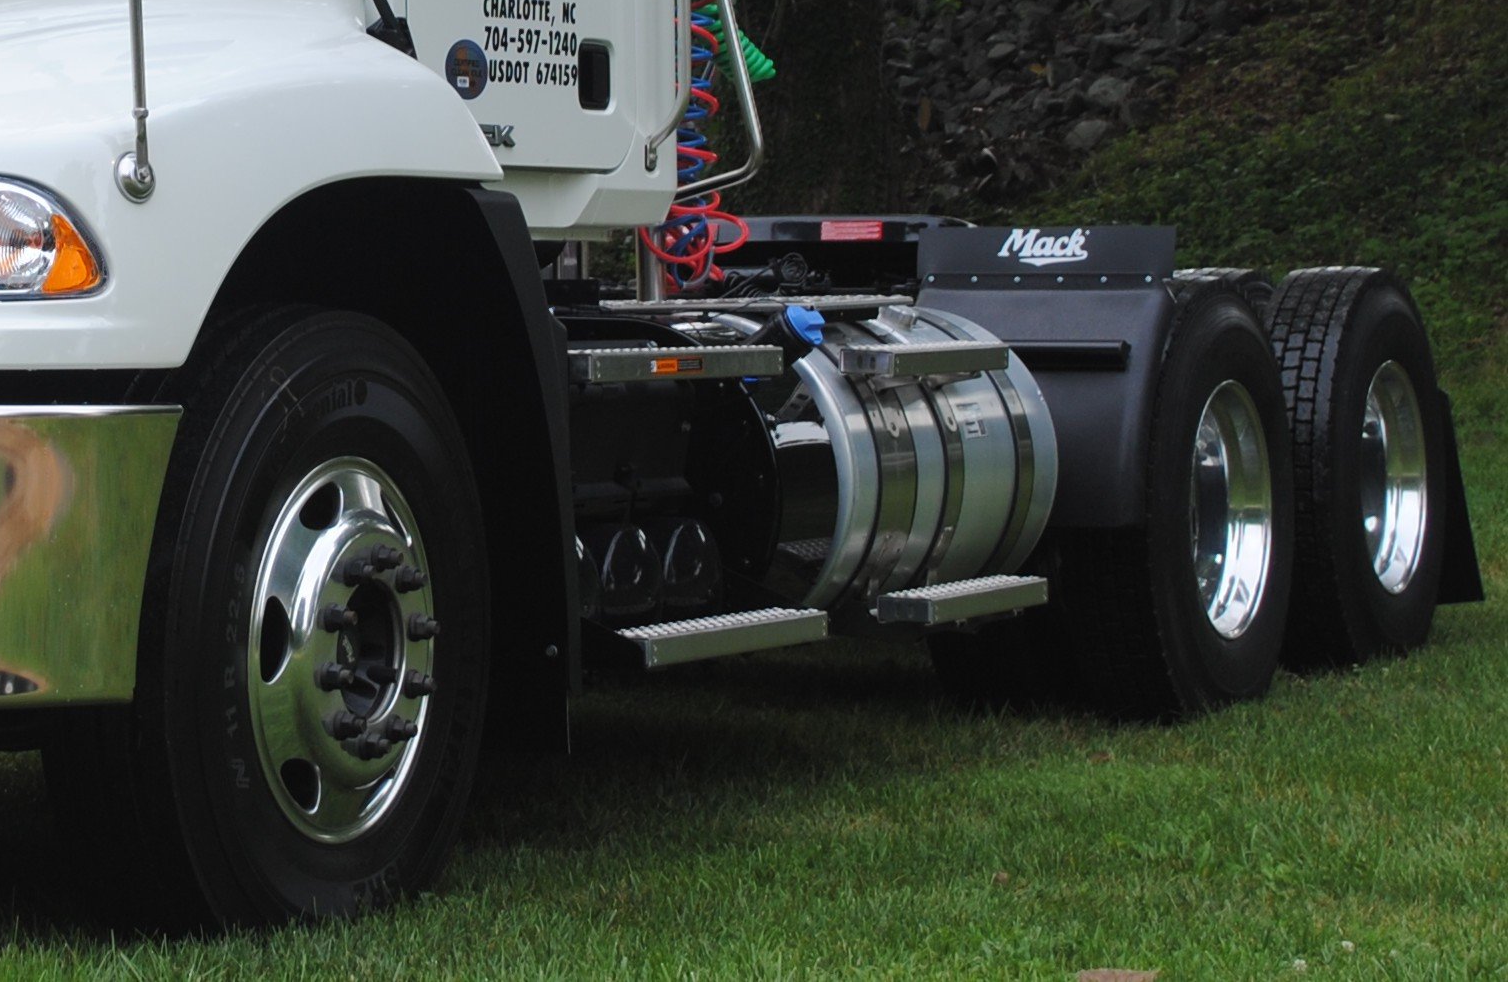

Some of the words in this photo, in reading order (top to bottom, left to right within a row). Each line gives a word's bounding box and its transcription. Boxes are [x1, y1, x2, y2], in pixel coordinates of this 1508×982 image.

[562, 2, 577, 24] NC
[484, 26, 577, 57] 704-597-1240
[489, 59, 530, 84] USDOT
[536, 62, 578, 87] 674159
[997, 228, 1089, 267] Mack
